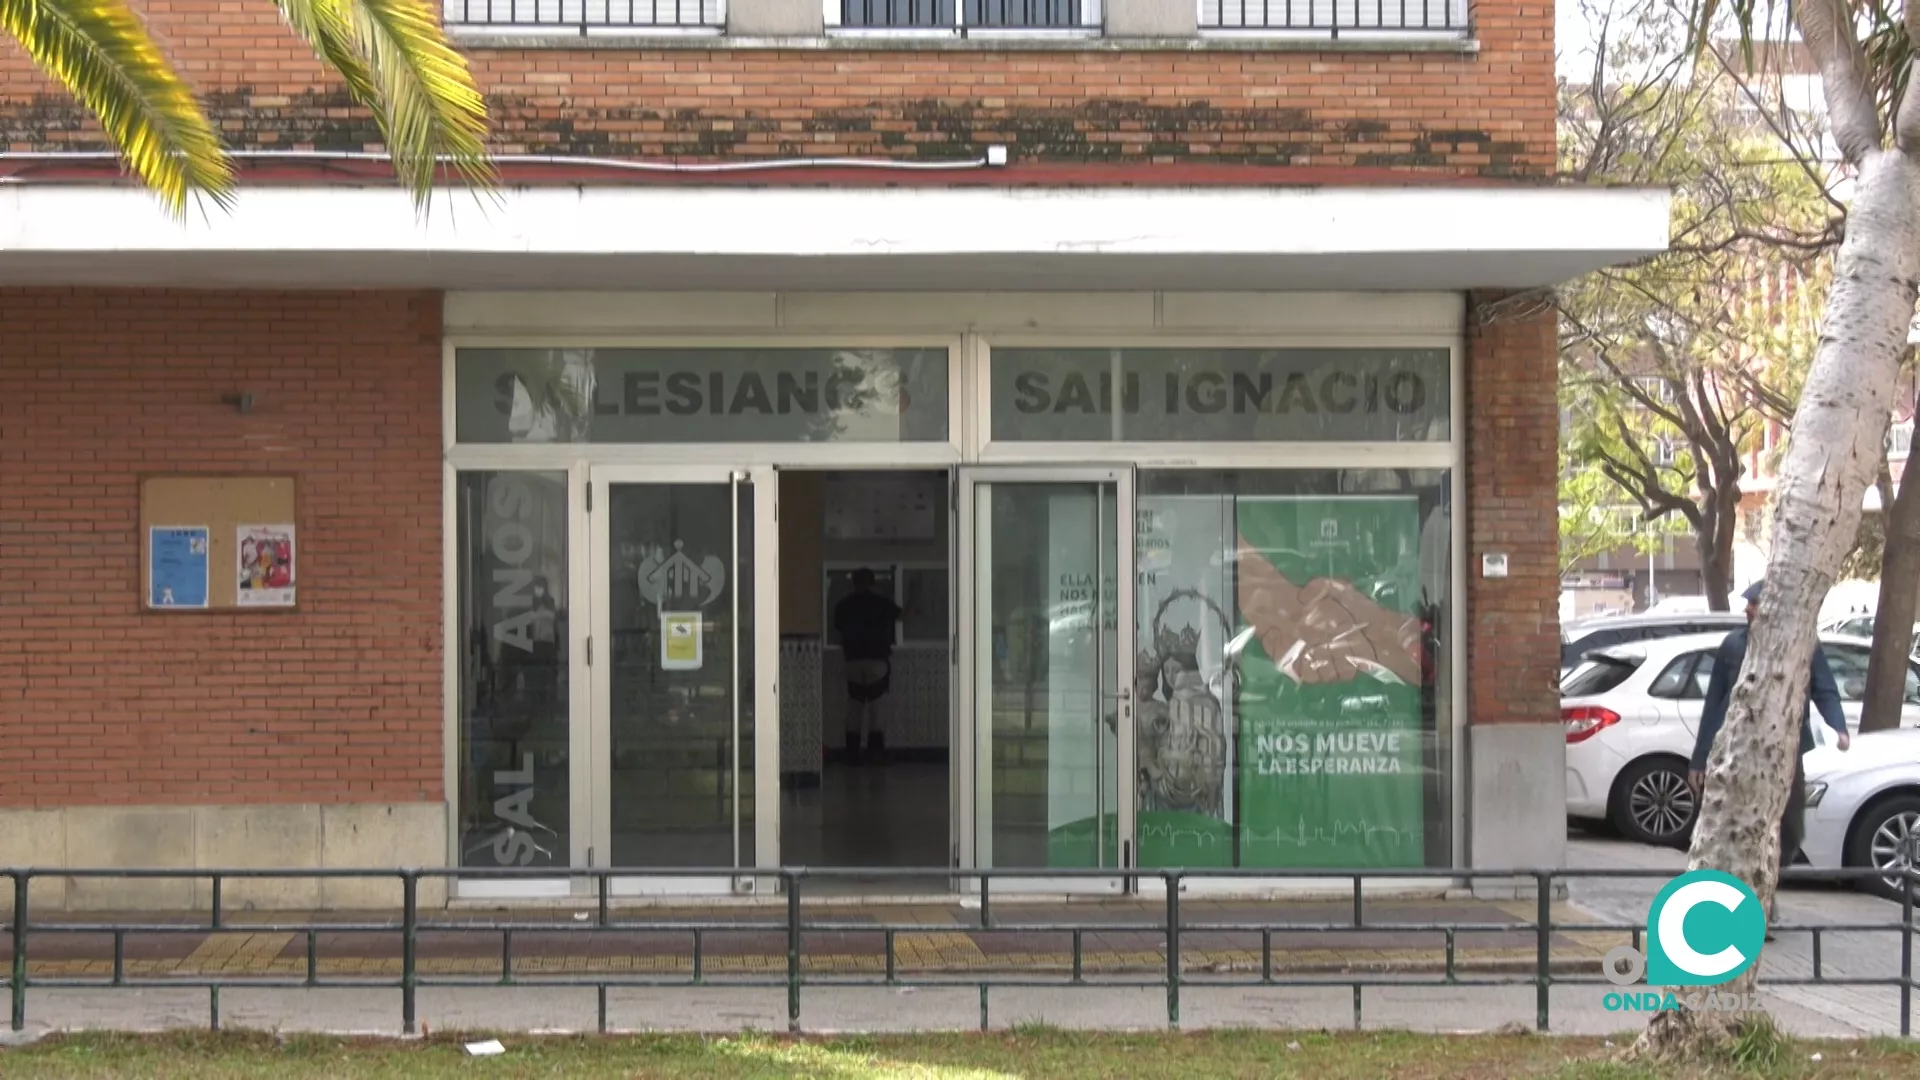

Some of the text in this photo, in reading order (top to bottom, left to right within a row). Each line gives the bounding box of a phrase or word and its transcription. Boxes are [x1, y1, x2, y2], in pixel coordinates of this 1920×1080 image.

[1014, 371, 1426, 415] SAN IGNACIO
[1257, 733, 1401, 753] NOS MUEVE
[1258, 757, 1401, 775] LA ESPERANZA
